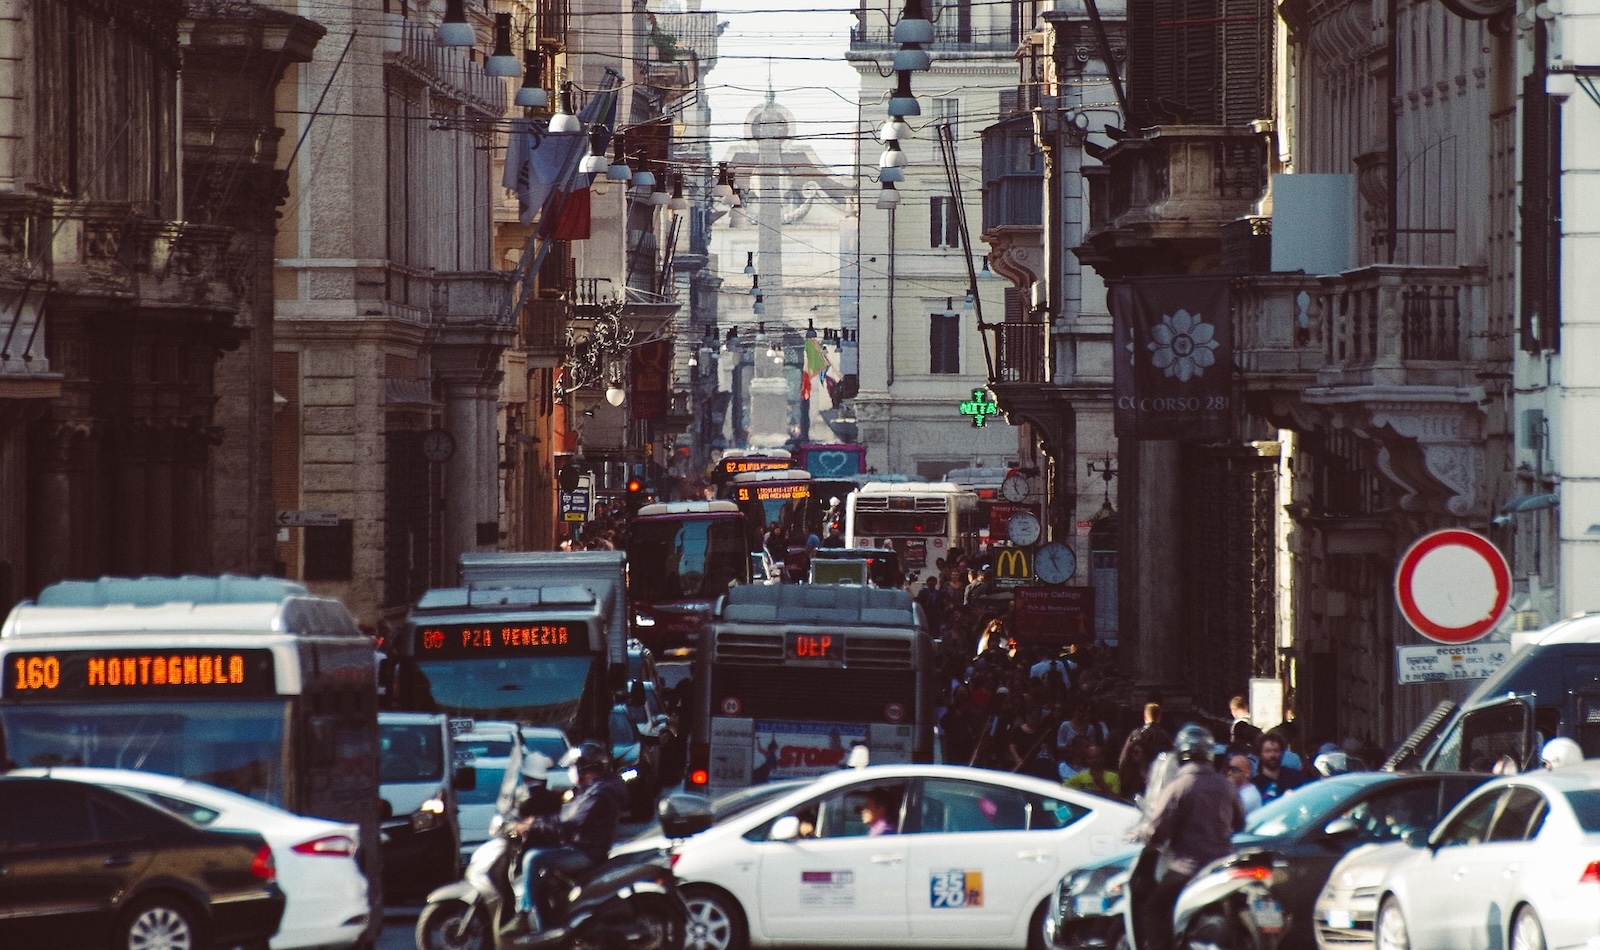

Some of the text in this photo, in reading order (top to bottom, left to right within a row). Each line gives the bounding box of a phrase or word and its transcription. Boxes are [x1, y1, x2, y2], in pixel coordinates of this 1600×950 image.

[1140, 397, 1200, 412] CORSO
[727, 461, 736, 473] 62
[738, 488, 749, 501] 51
[1020, 591, 1081, 600] Trinity College
[462, 628, 492, 648] PZA
[502, 626, 568, 647] VENEZIA
[797, 636, 831, 656] DEP
[1437, 647, 1478, 655] eccetto
[15, 654, 244, 690] 160 MONTAGNOLA
[933, 874, 964, 892] 35
[933, 891, 964, 907] 70
